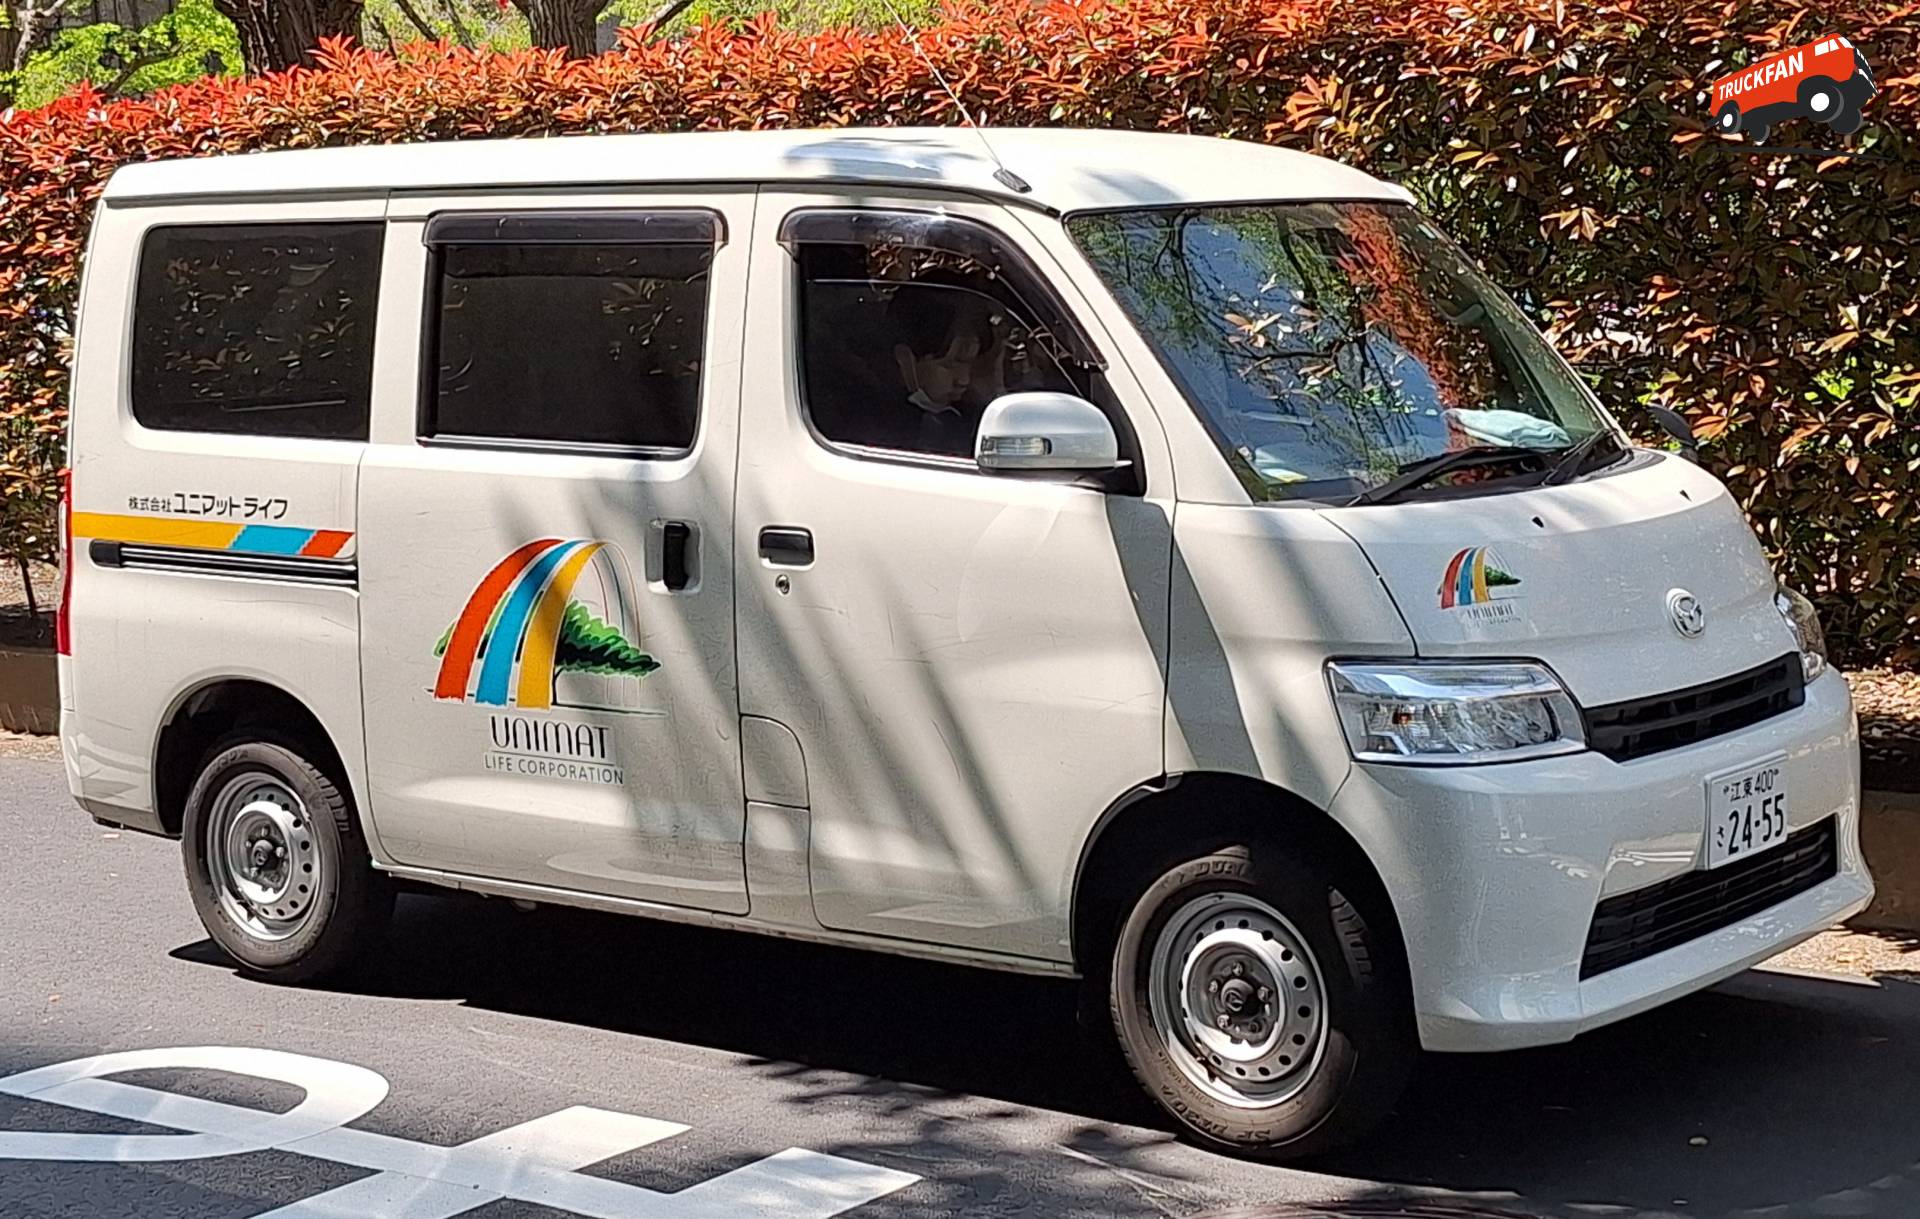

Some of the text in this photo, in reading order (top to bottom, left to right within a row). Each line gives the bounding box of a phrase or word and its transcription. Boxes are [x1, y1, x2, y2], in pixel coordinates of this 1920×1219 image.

[491, 716, 609, 759] UNIMAT
[485, 755, 624, 784] LIFE CORPORATION
[1728, 793, 1784, 855] 24-55
